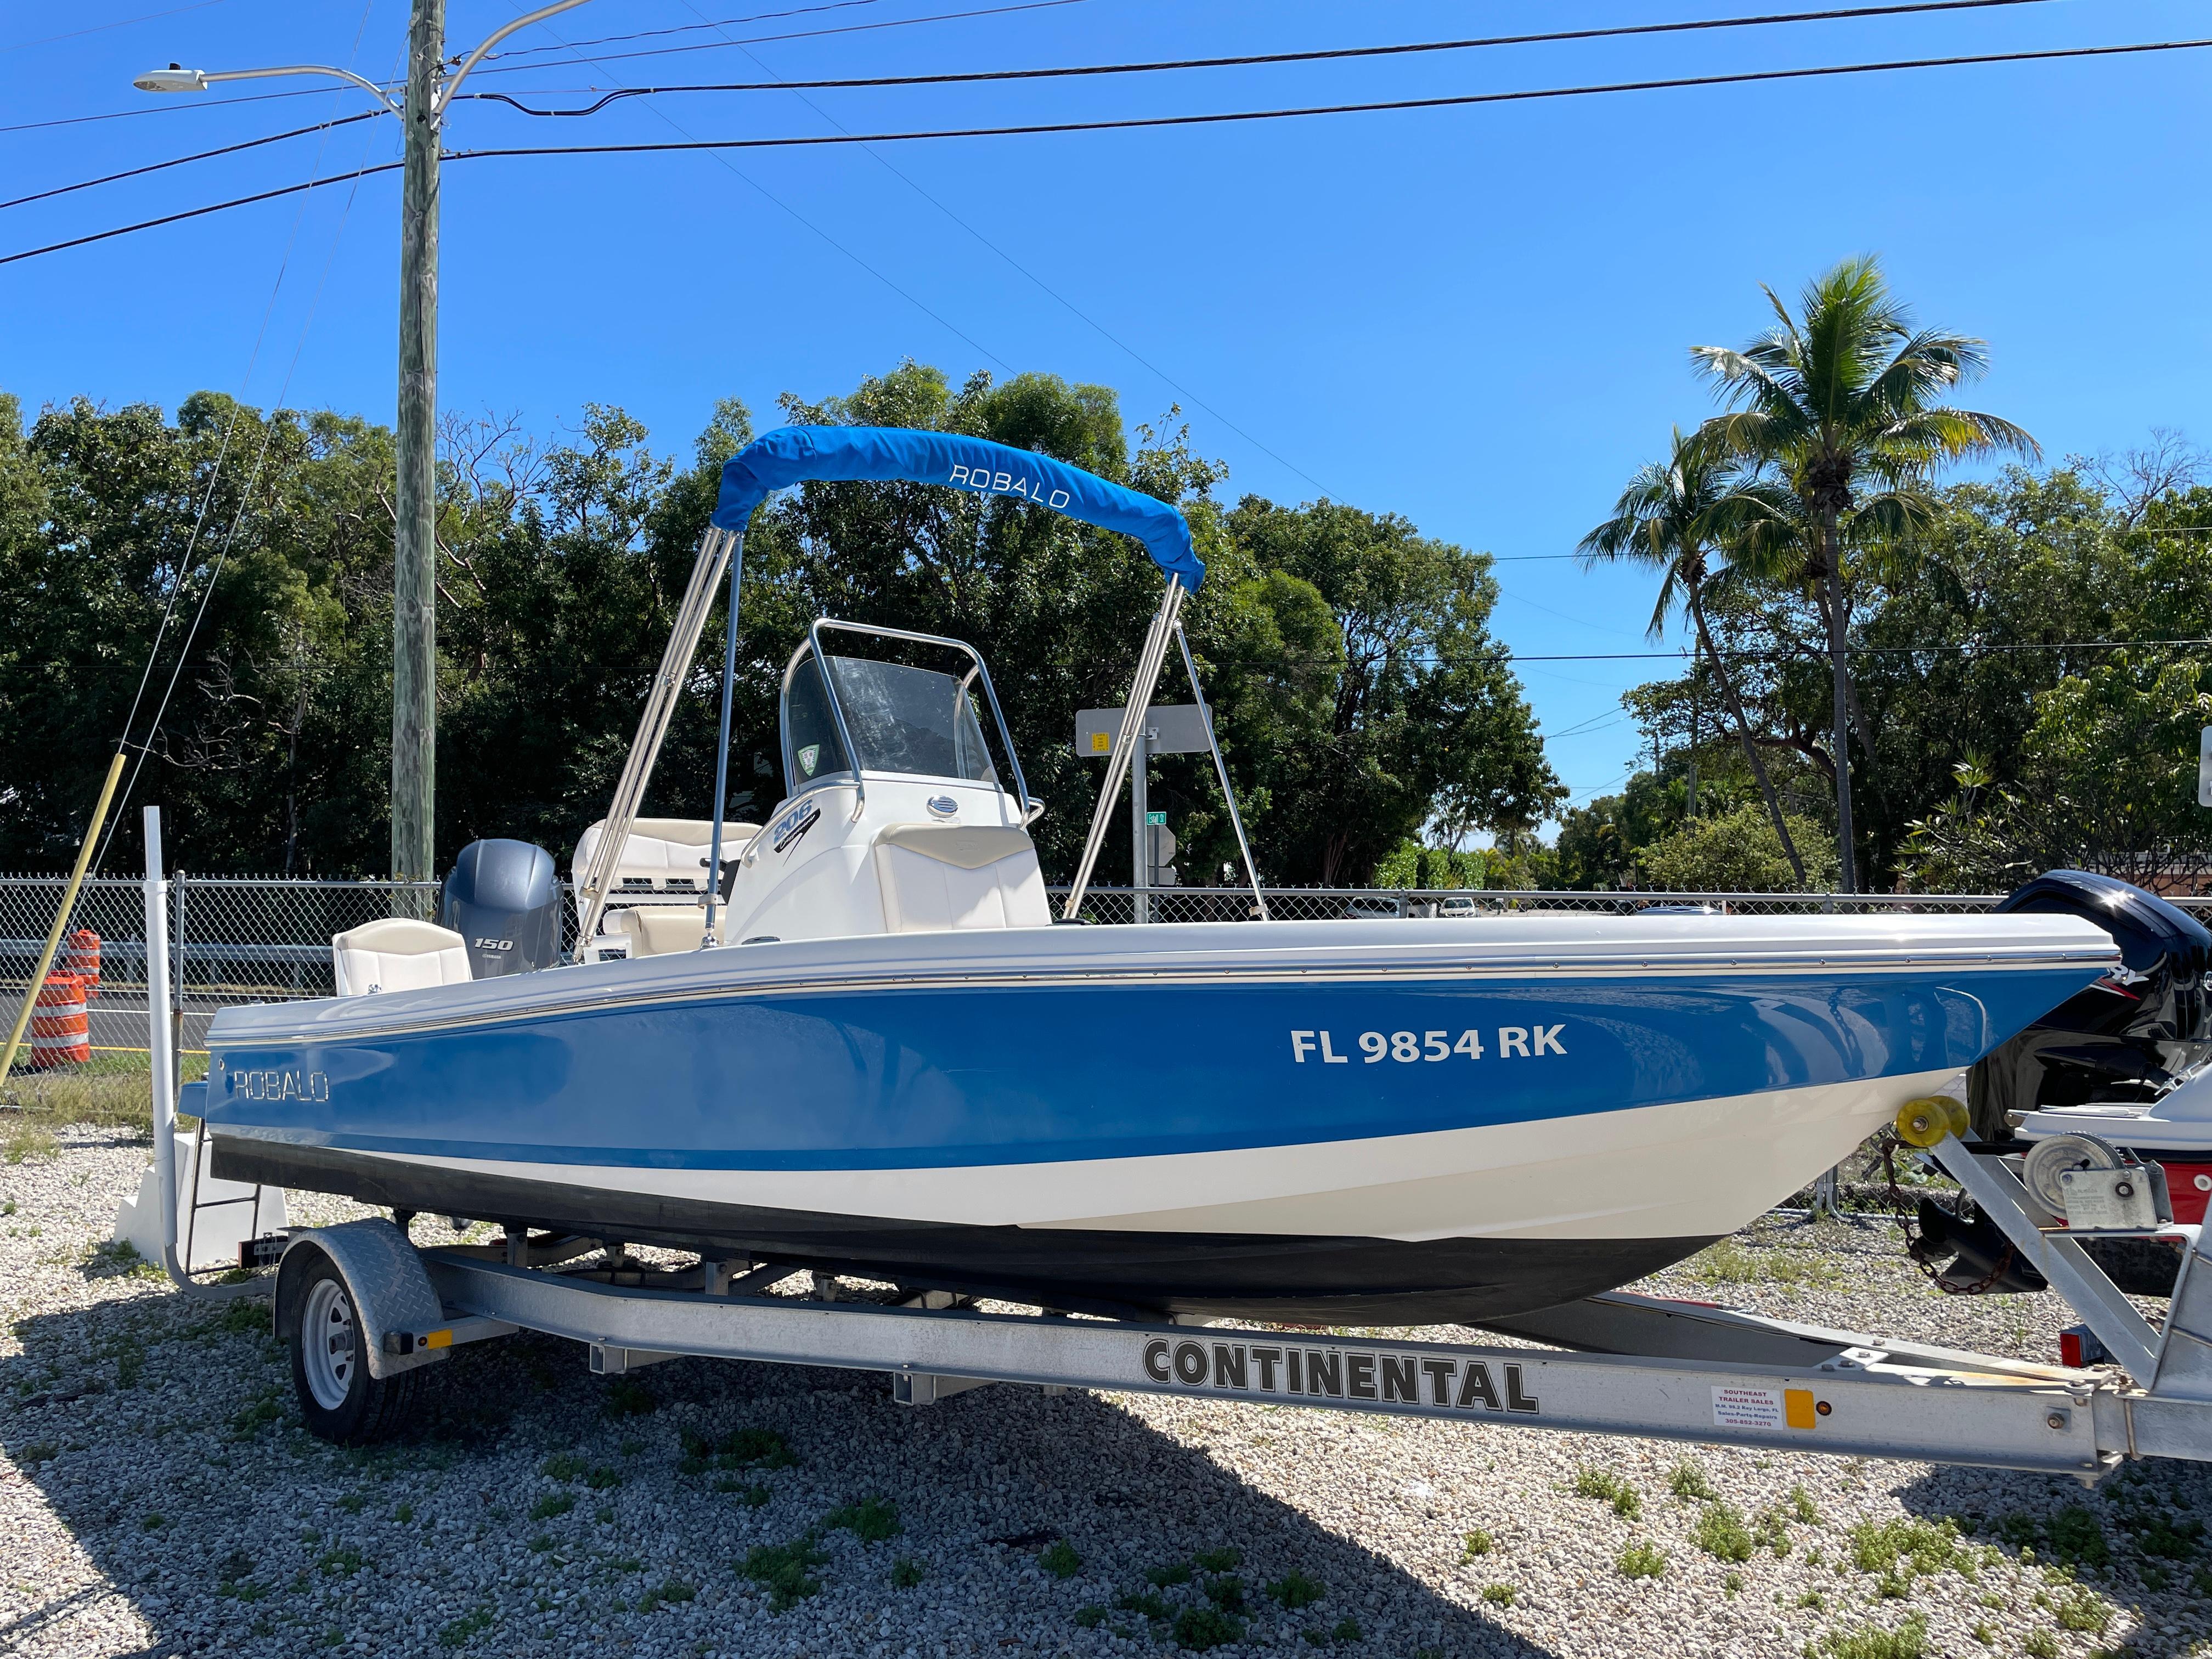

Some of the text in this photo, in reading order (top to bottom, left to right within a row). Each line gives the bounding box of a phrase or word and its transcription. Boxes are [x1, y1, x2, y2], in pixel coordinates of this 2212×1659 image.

[949, 465, 1070, 509] ROBALO
[774, 799, 813, 844] 206
[475, 938, 514, 951] 150
[1291, 1024, 1568, 1064] FL 9854 RK
[234, 1070, 329, 1102] ROBALO
[1143, 1338, 1539, 1415] CONTINENTAL
[1725, 1418, 1771, 1426] 305-852-3270
